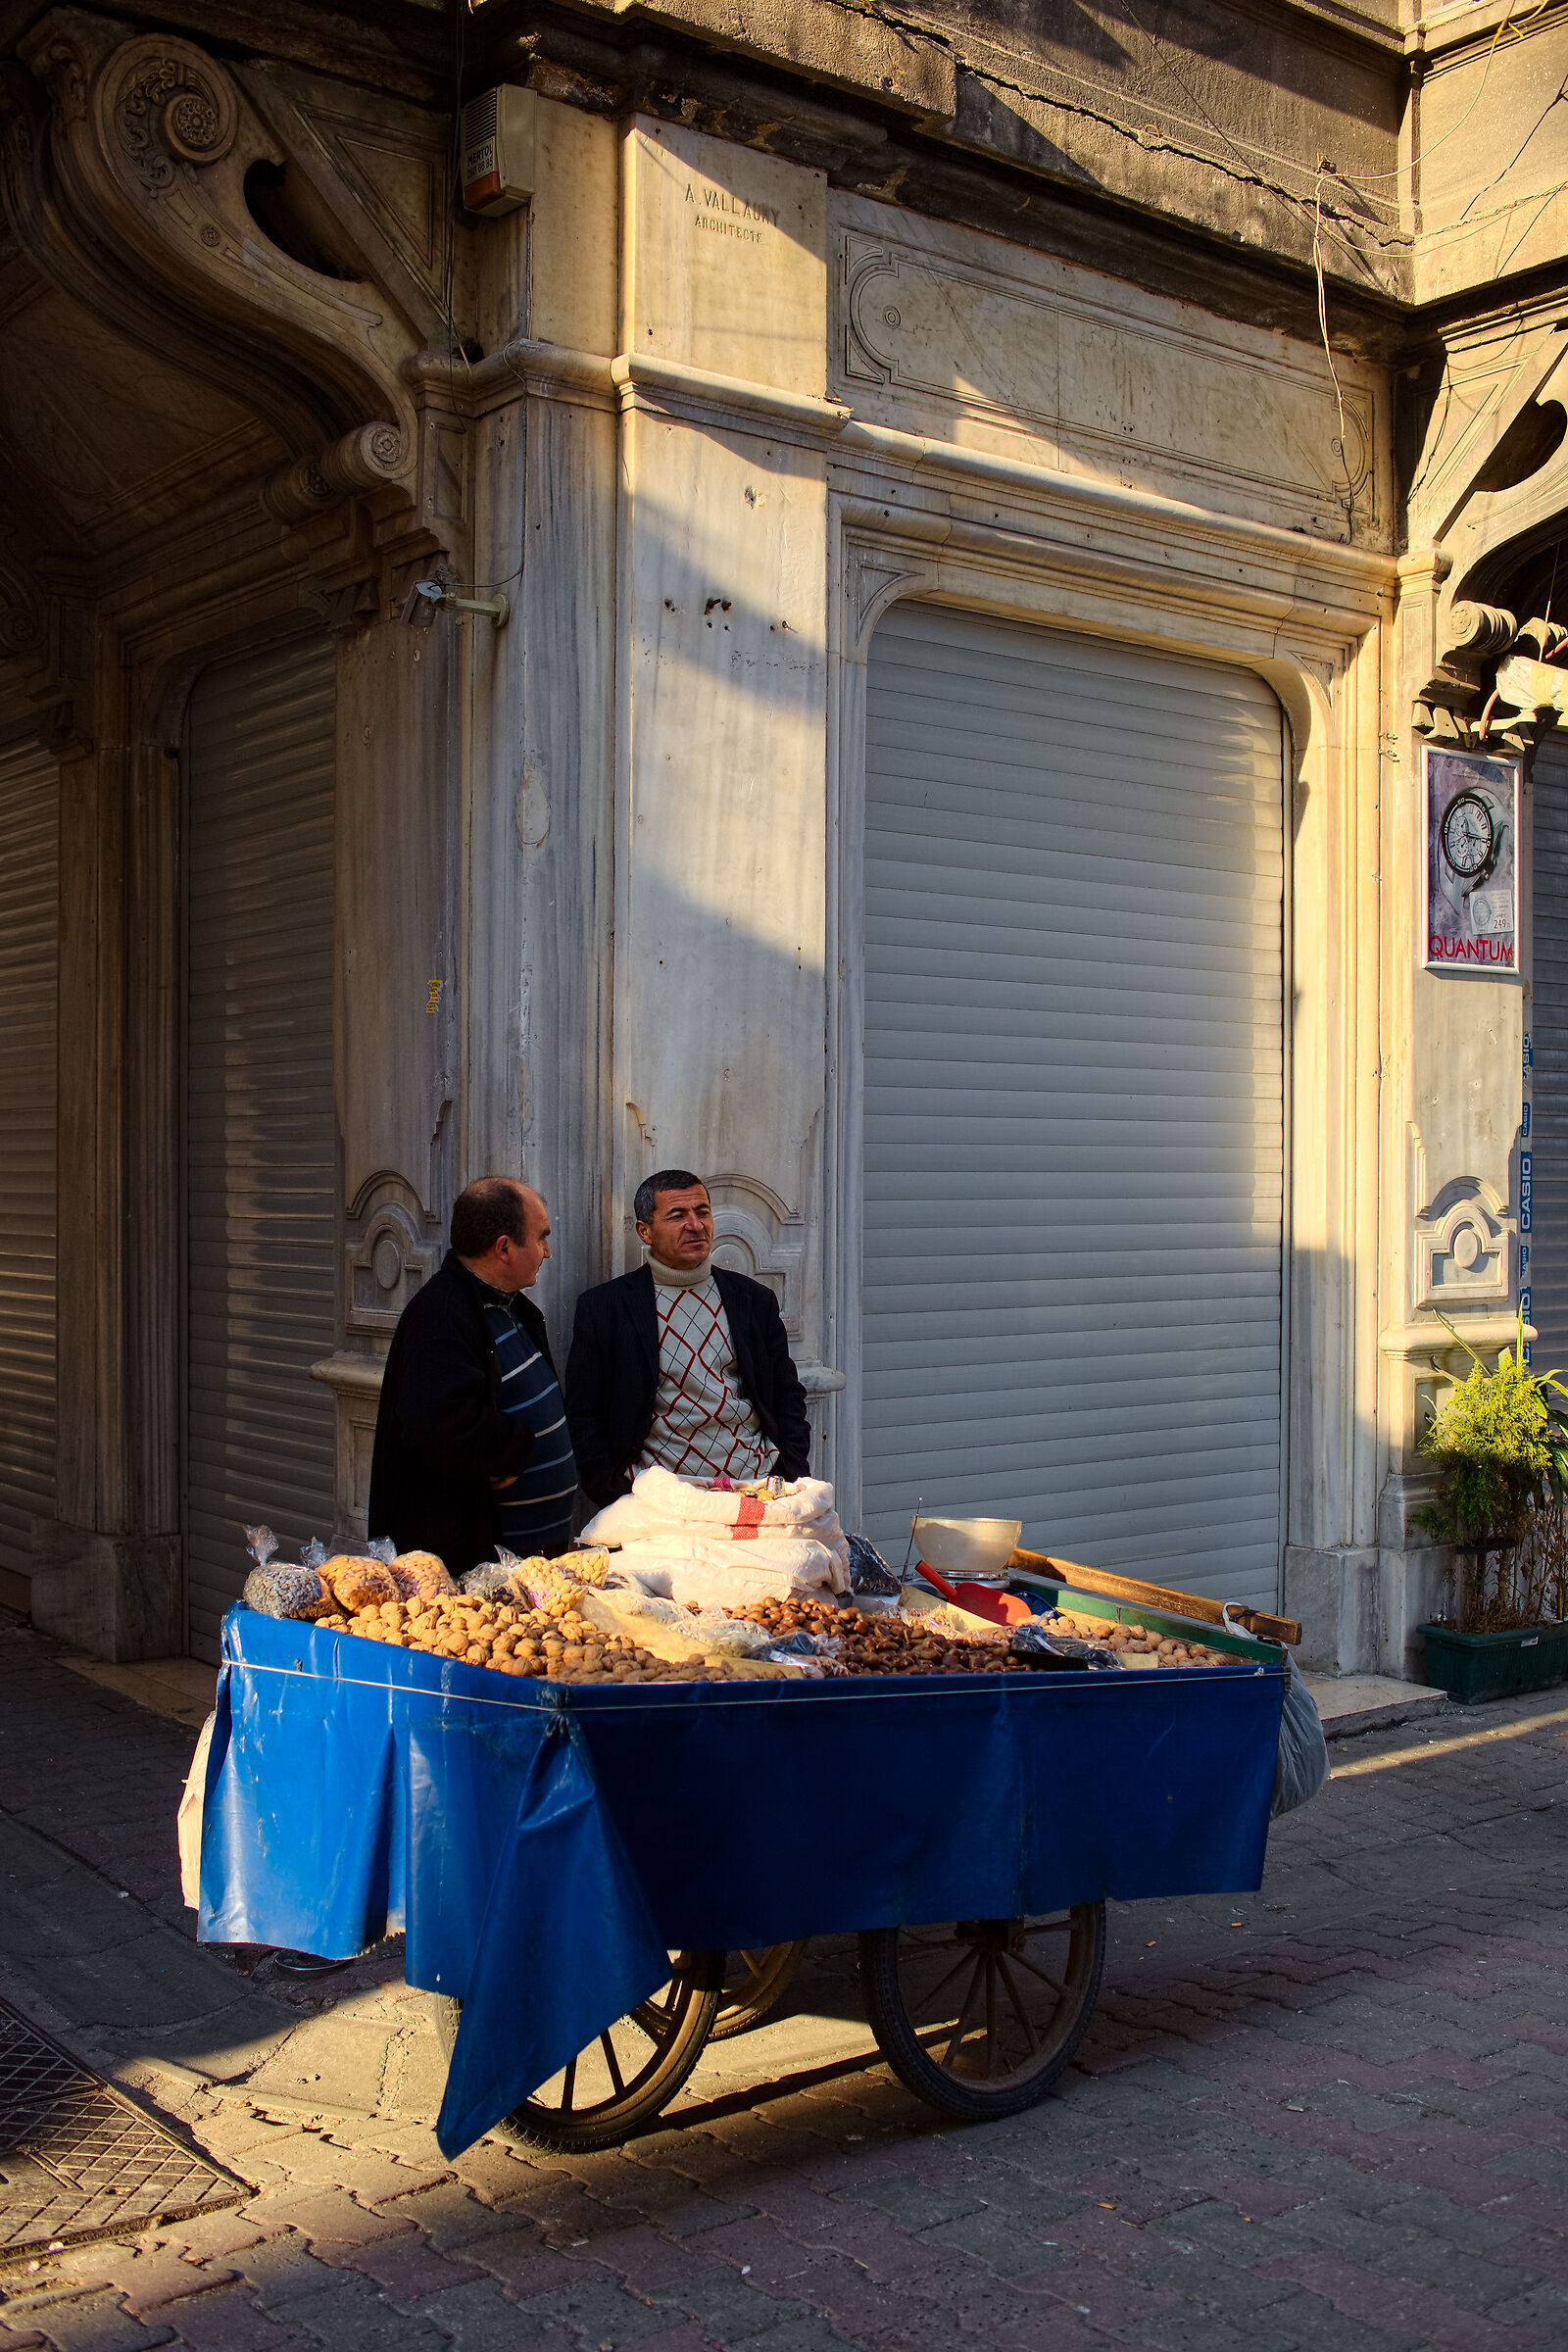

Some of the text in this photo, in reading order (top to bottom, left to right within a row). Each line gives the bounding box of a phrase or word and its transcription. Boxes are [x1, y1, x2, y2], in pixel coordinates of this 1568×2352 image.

[467, 143, 493, 167] MERTOL
[695, 215, 763, 243] ARCHITECTE
[1494, 919, 1506, 929] 249
[1429, 935, 1514, 961] QUANTUM
[1521, 1157, 1531, 1230] CASIO
